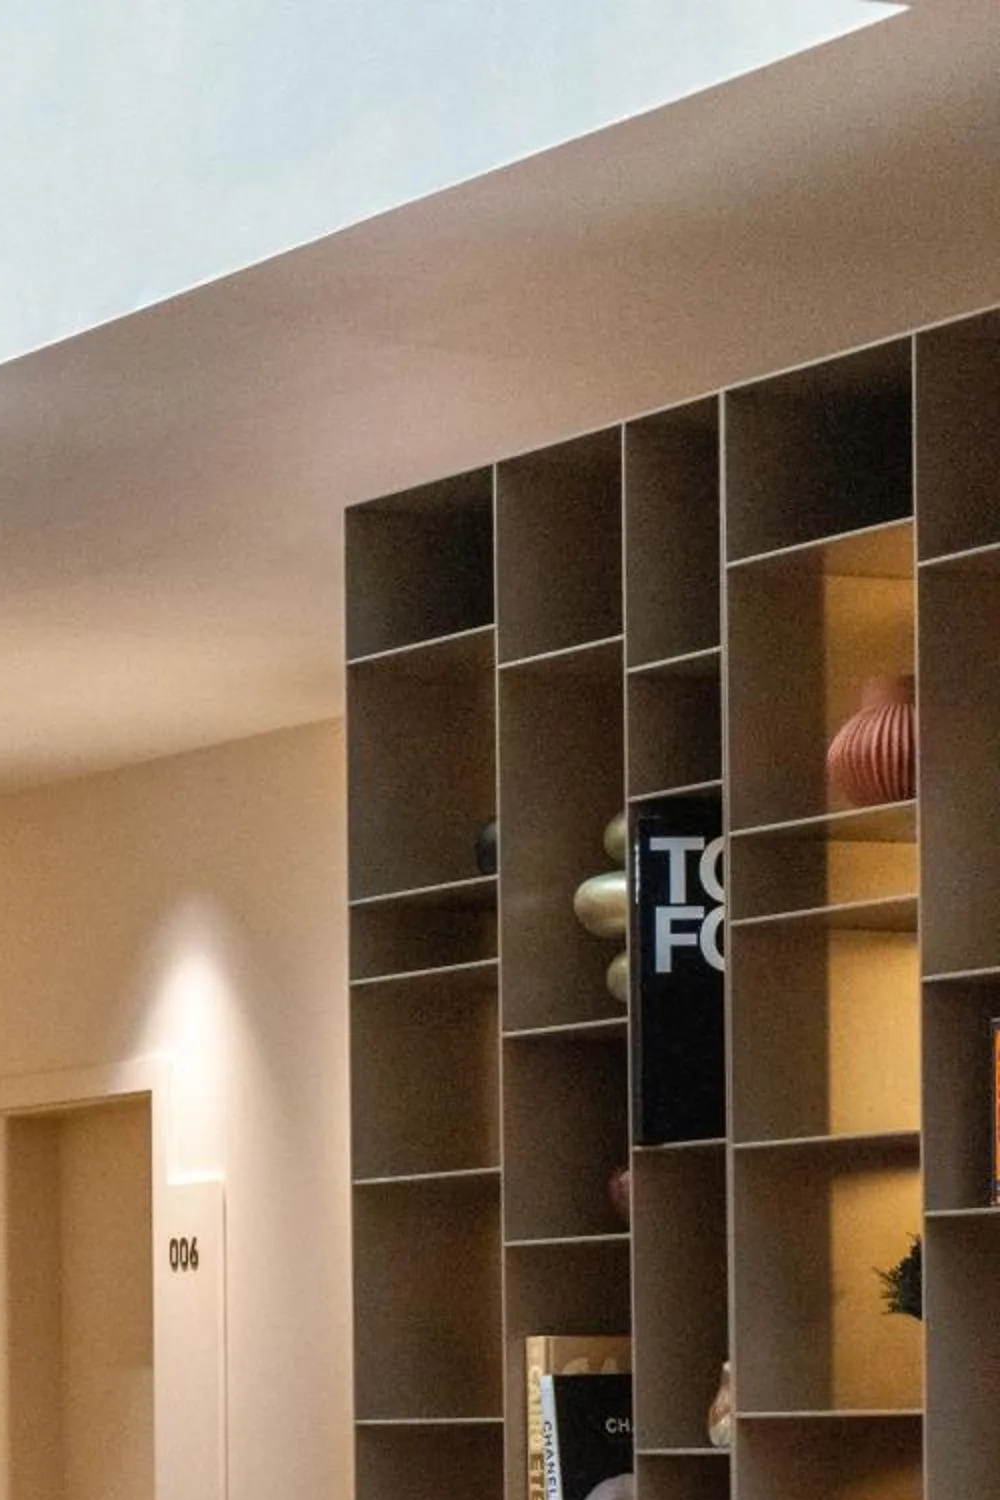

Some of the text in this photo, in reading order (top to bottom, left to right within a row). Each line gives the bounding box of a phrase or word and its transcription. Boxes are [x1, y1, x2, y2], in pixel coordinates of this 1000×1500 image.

[169, 1236, 199, 1272] 006
[605, 1417, 633, 1434] CH
[543, 1420, 557, 1494] CHANEL
